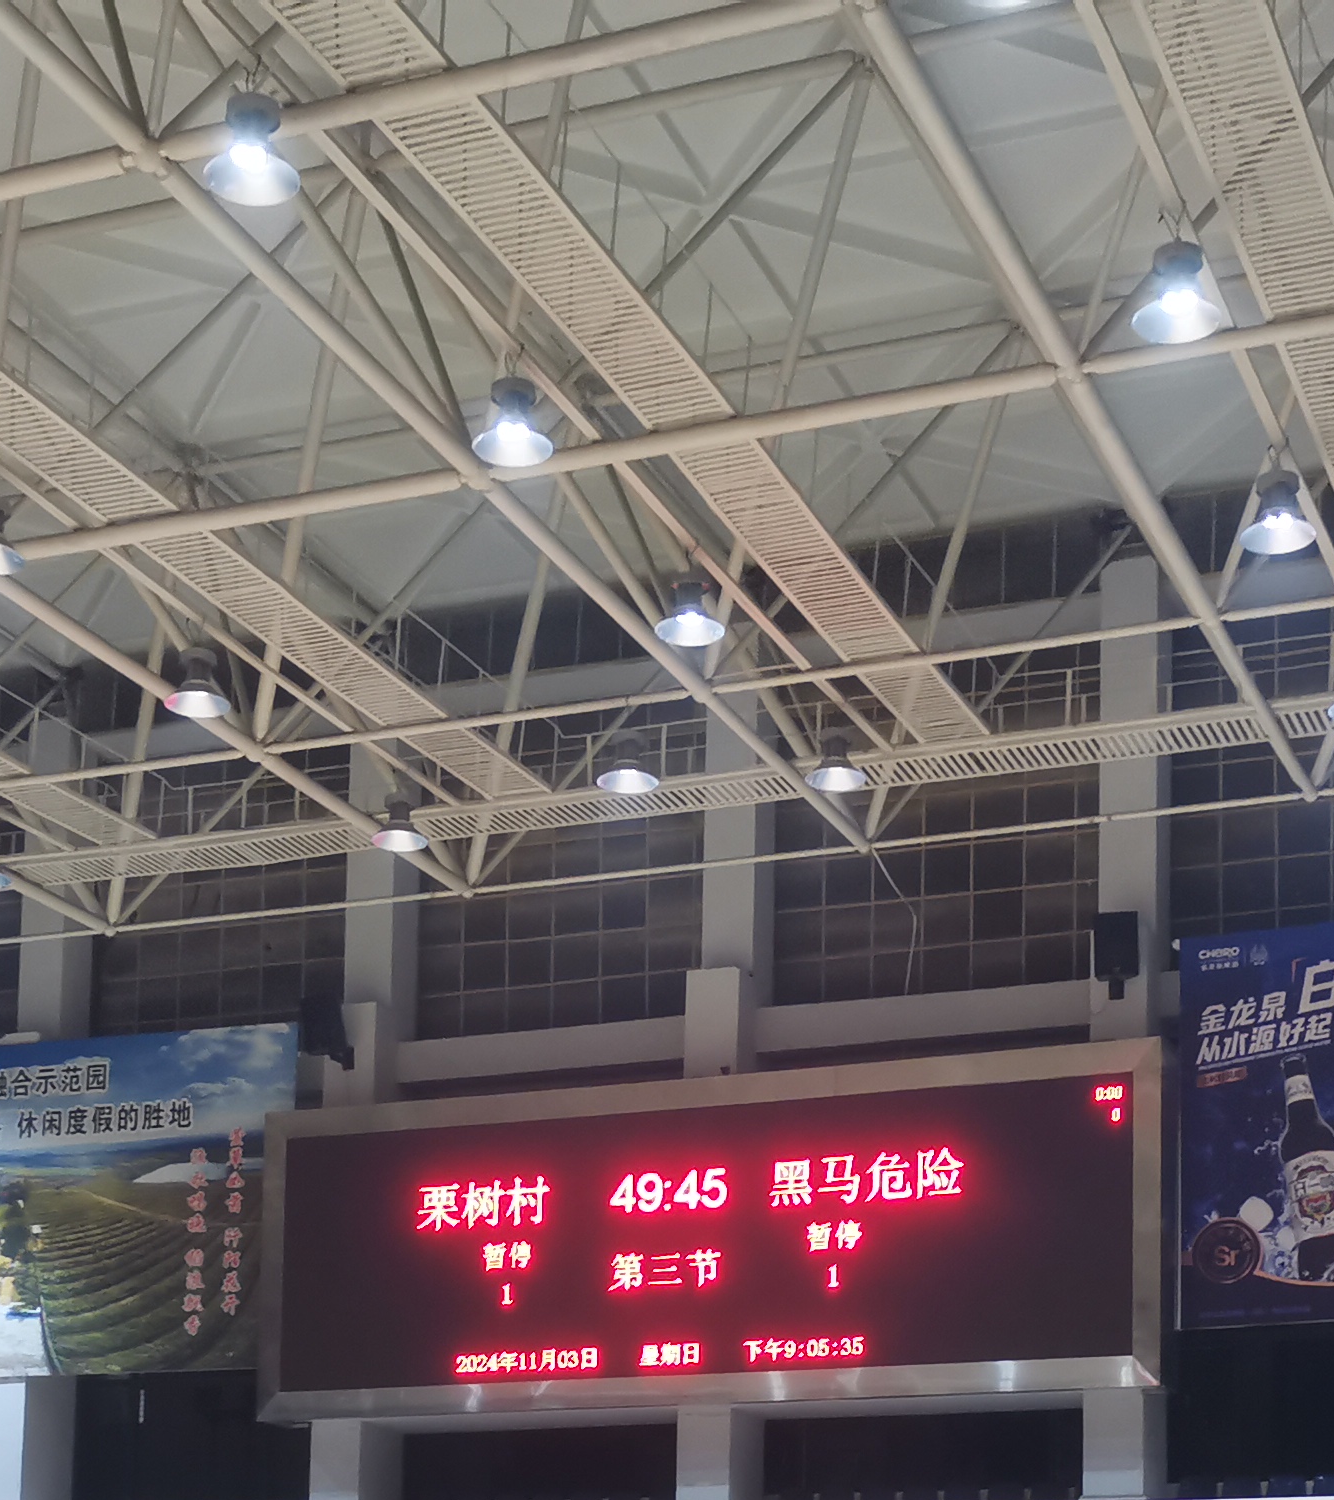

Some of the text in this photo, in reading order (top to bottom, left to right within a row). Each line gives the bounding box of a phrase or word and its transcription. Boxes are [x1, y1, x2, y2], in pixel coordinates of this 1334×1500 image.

[1197, 990, 1286, 1035] 金龙泉
[1196, 1012, 1333, 1065] 从水源好起
[17, 1100, 193, 1139] 休闲度假的胜地
[417, 1146, 965, 1231] 栗树村 49:45 黑马危险
[807, 1219, 862, 1253] 暂停
[482, 1240, 532, 1272] 暂停
[608, 1249, 722, 1291] 第三节
[501, 1283, 514, 1306] 1
[827, 1263, 840, 1289] 1
[455, 1336, 864, 1374] 2024年11月03日 星期日 下午9:05:35
